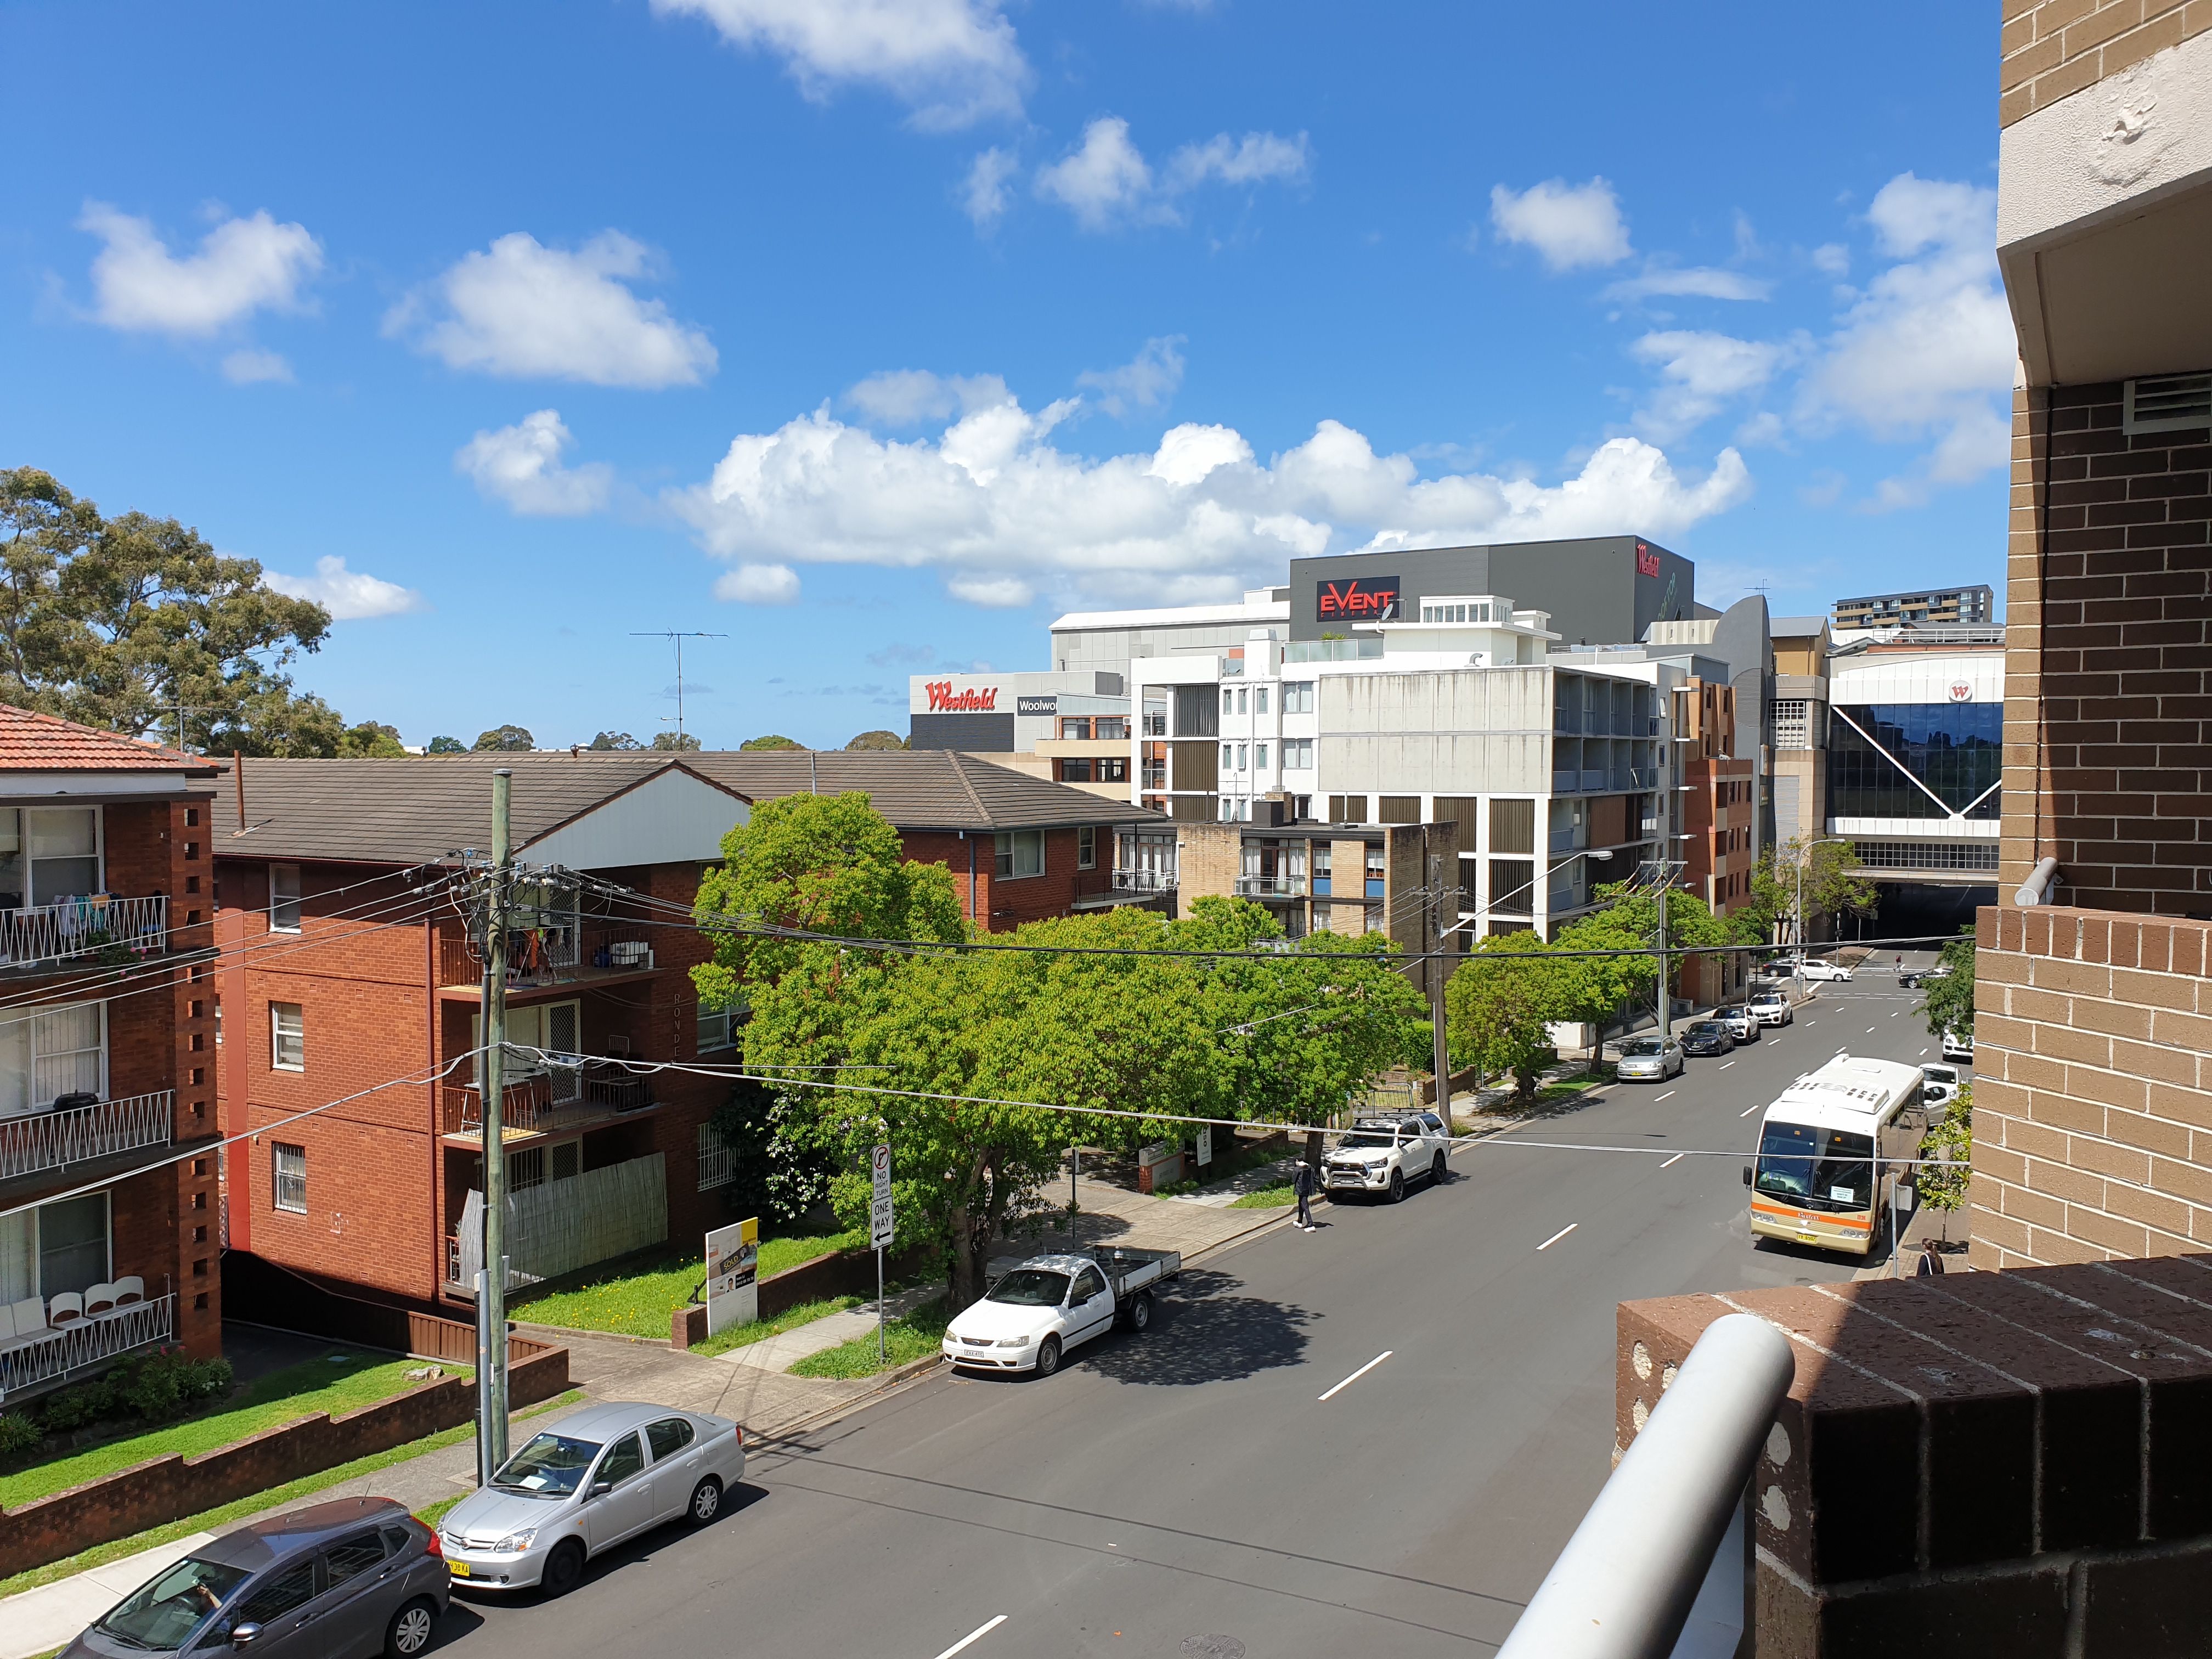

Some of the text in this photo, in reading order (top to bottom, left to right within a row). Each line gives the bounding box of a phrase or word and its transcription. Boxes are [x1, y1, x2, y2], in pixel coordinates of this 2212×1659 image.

[1637, 544, 1660, 577] Westfield
[1321, 582, 1394, 611] EVENT
[1321, 610, 1378, 618] CINEMA
[925, 680, 998, 711] Westfield
[1951, 685, 1969, 698] W
[877, 1171, 887, 1181] NO
[876, 1180, 888, 1189] RIGHT
[875, 1201, 889, 1216] ONE
[874, 1215, 890, 1231] WAY
[724, 1255, 738, 1270] SOLD
[462, 1564, 469, 1573] KA
